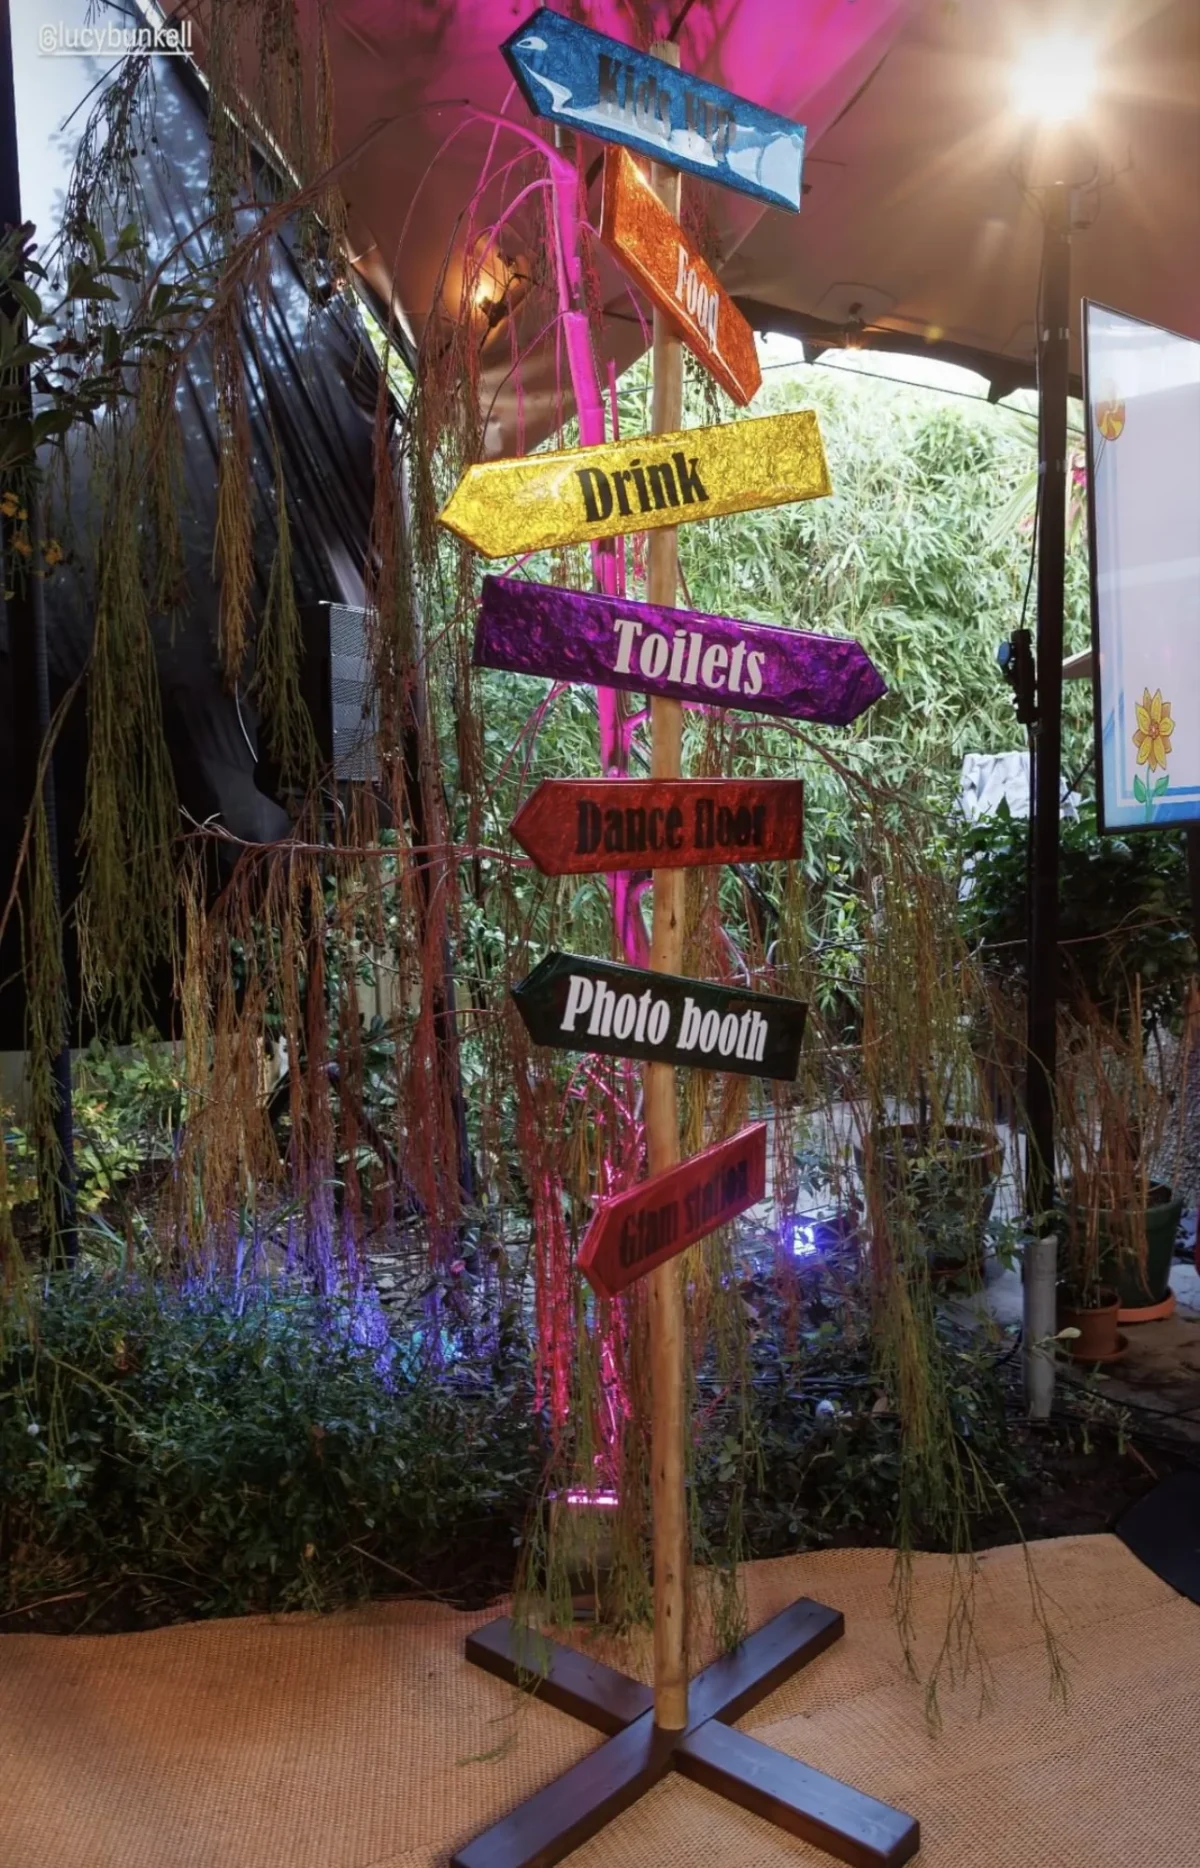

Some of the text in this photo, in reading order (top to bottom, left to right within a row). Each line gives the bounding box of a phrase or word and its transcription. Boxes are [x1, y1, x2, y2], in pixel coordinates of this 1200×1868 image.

[598, 54, 671, 143] Kids
[674, 243, 719, 351] Food
[574, 451, 709, 522] Drink
[613, 618, 765, 696] Toilets
[574, 798, 767, 854] Dance floor
[560, 975, 768, 1062] Photo booth
